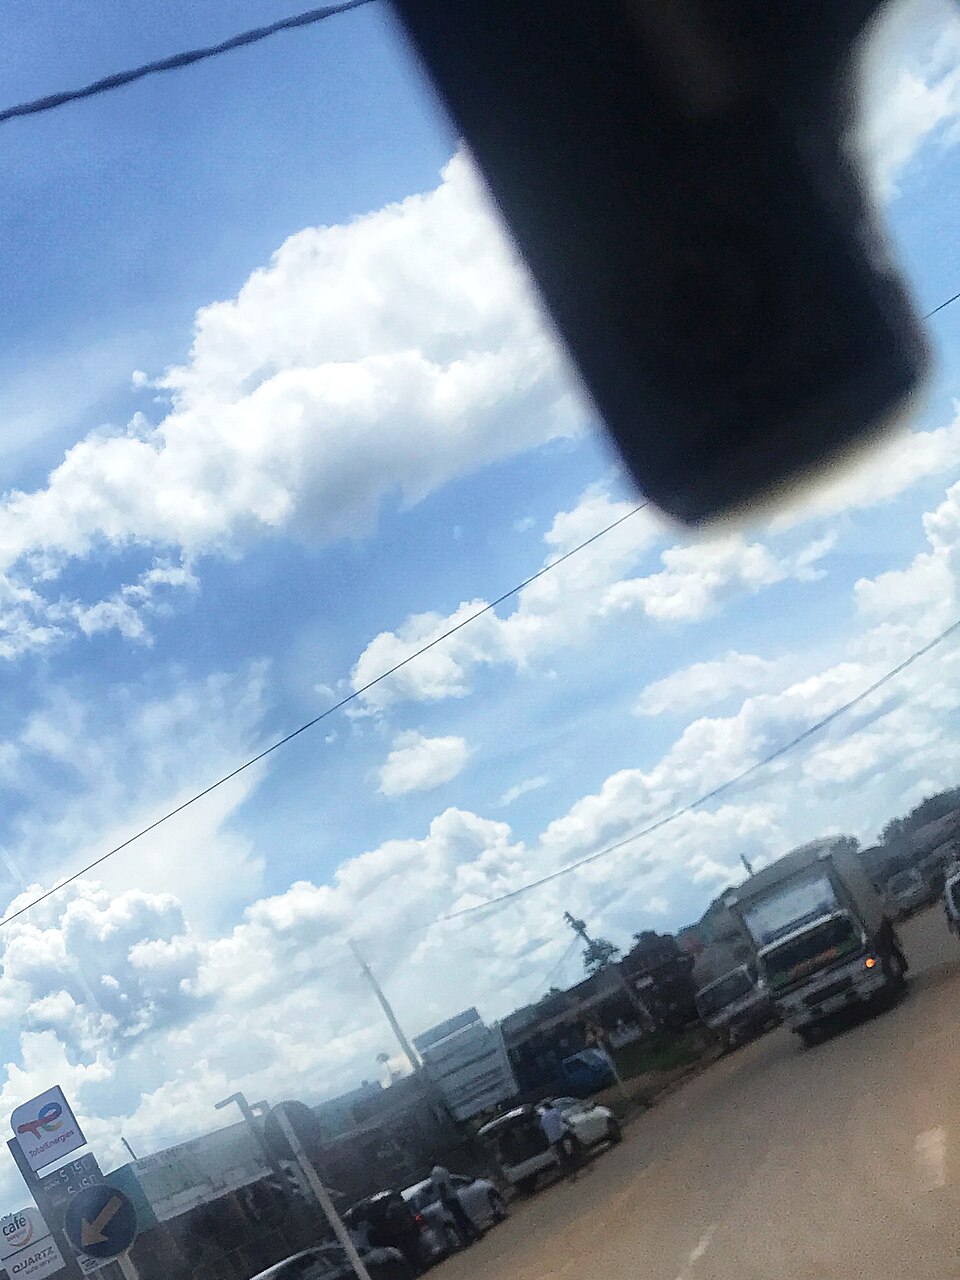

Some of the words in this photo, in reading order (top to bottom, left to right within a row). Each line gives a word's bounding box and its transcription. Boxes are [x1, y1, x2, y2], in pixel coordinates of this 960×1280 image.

[28, 1129, 75, 1157] TotalEnergies
[2, 1212, 27, 1236] café
[12, 1246, 54, 1274] QUARTZ
